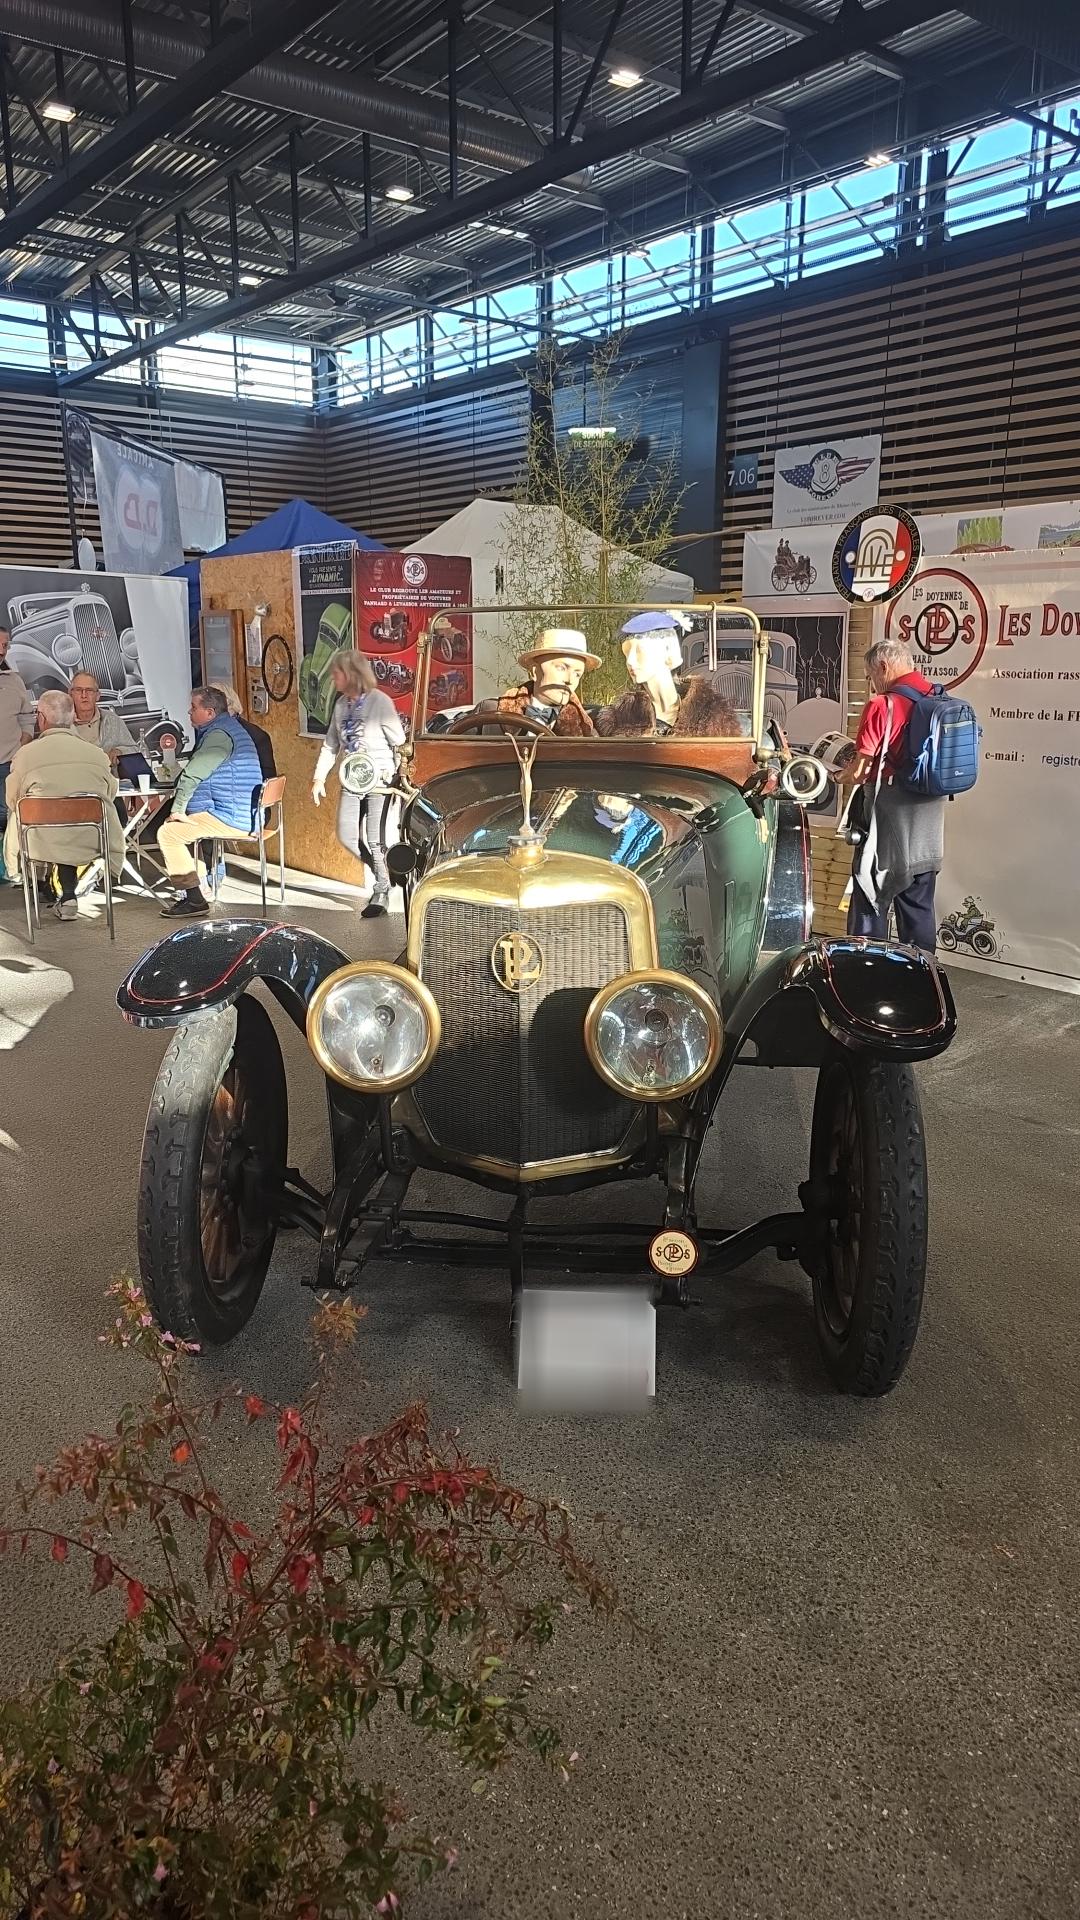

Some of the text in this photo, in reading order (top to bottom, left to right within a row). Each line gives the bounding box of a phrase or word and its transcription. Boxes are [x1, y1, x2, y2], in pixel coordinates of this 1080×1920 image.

[727, 467, 755, 487] 7.06
[878, 505, 895, 514] DES
[926, 591, 963, 601] DOYENNES
[959, 601, 969, 610] DE
[992, 668, 1054, 680] Association
[989, 706, 1035, 720] Membre
[1037, 709, 1051, 720] de
[1053, 709, 1064, 721] la
[985, 750, 1018, 762] e-mail
